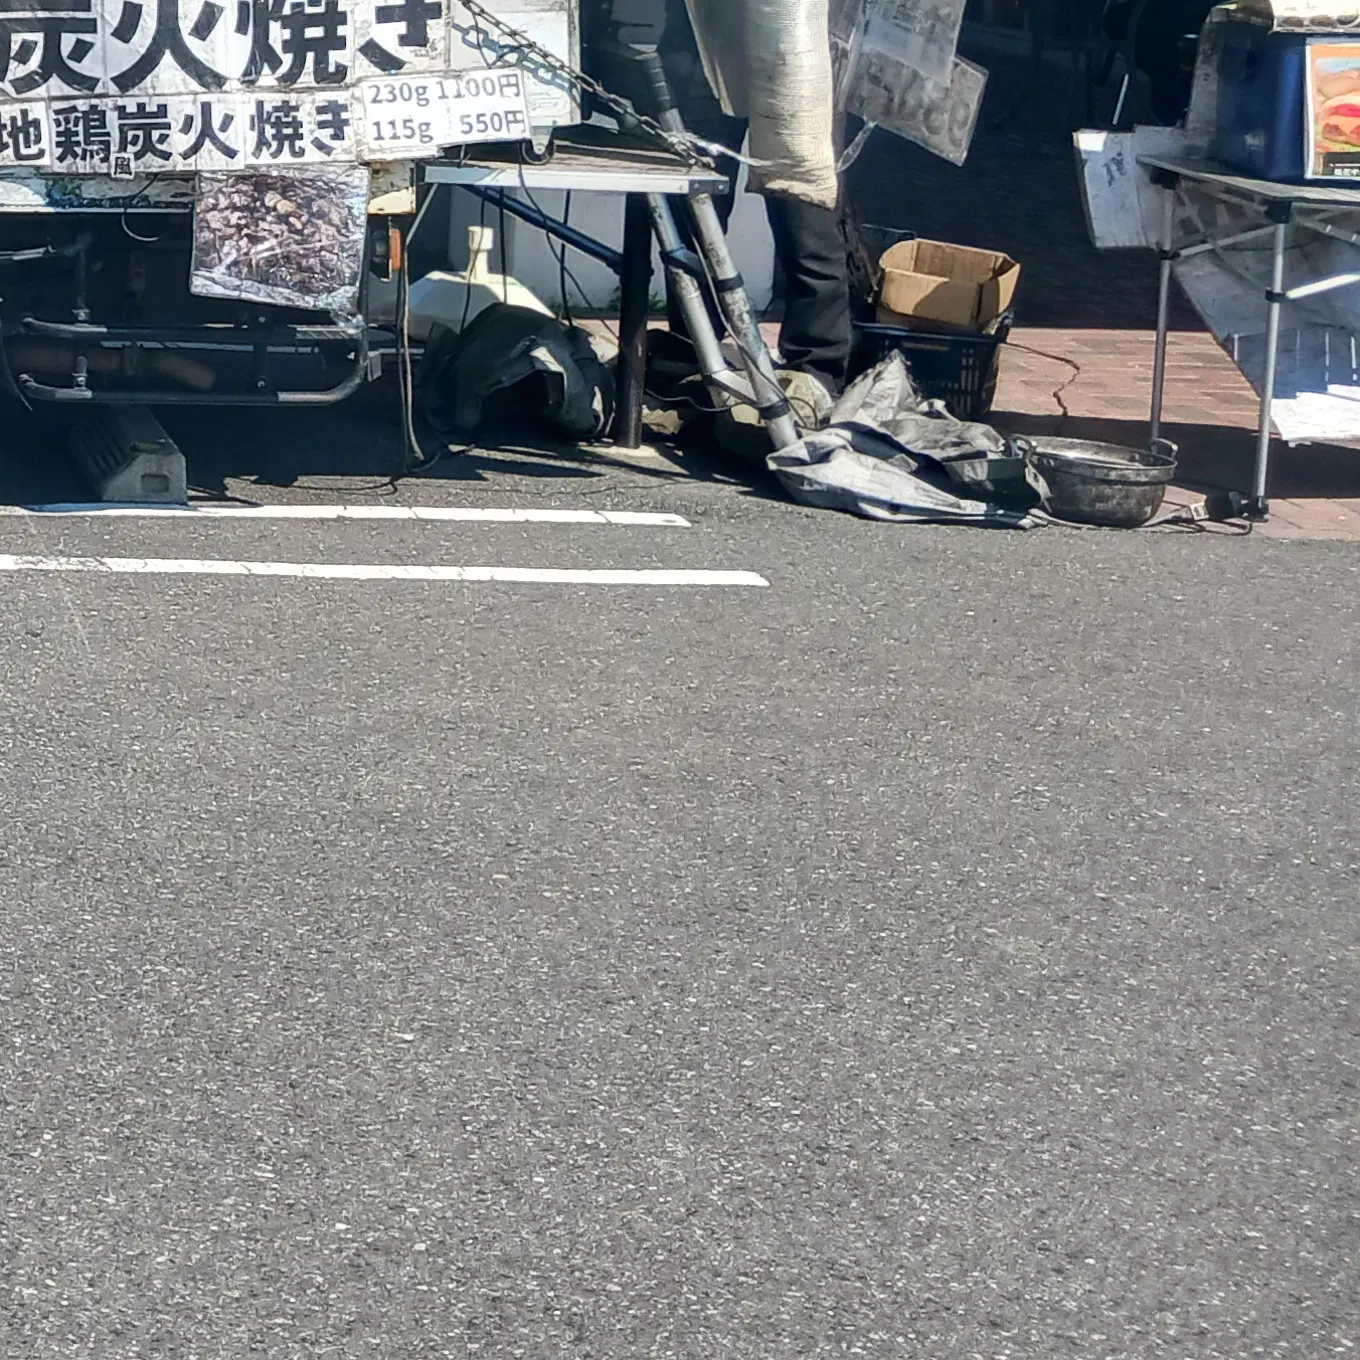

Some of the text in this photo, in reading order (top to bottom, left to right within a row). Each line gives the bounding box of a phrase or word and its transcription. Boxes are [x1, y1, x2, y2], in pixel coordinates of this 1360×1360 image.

[368, 73, 521, 107] 230g 1100円
[372, 109, 526, 144] 115g 550円
